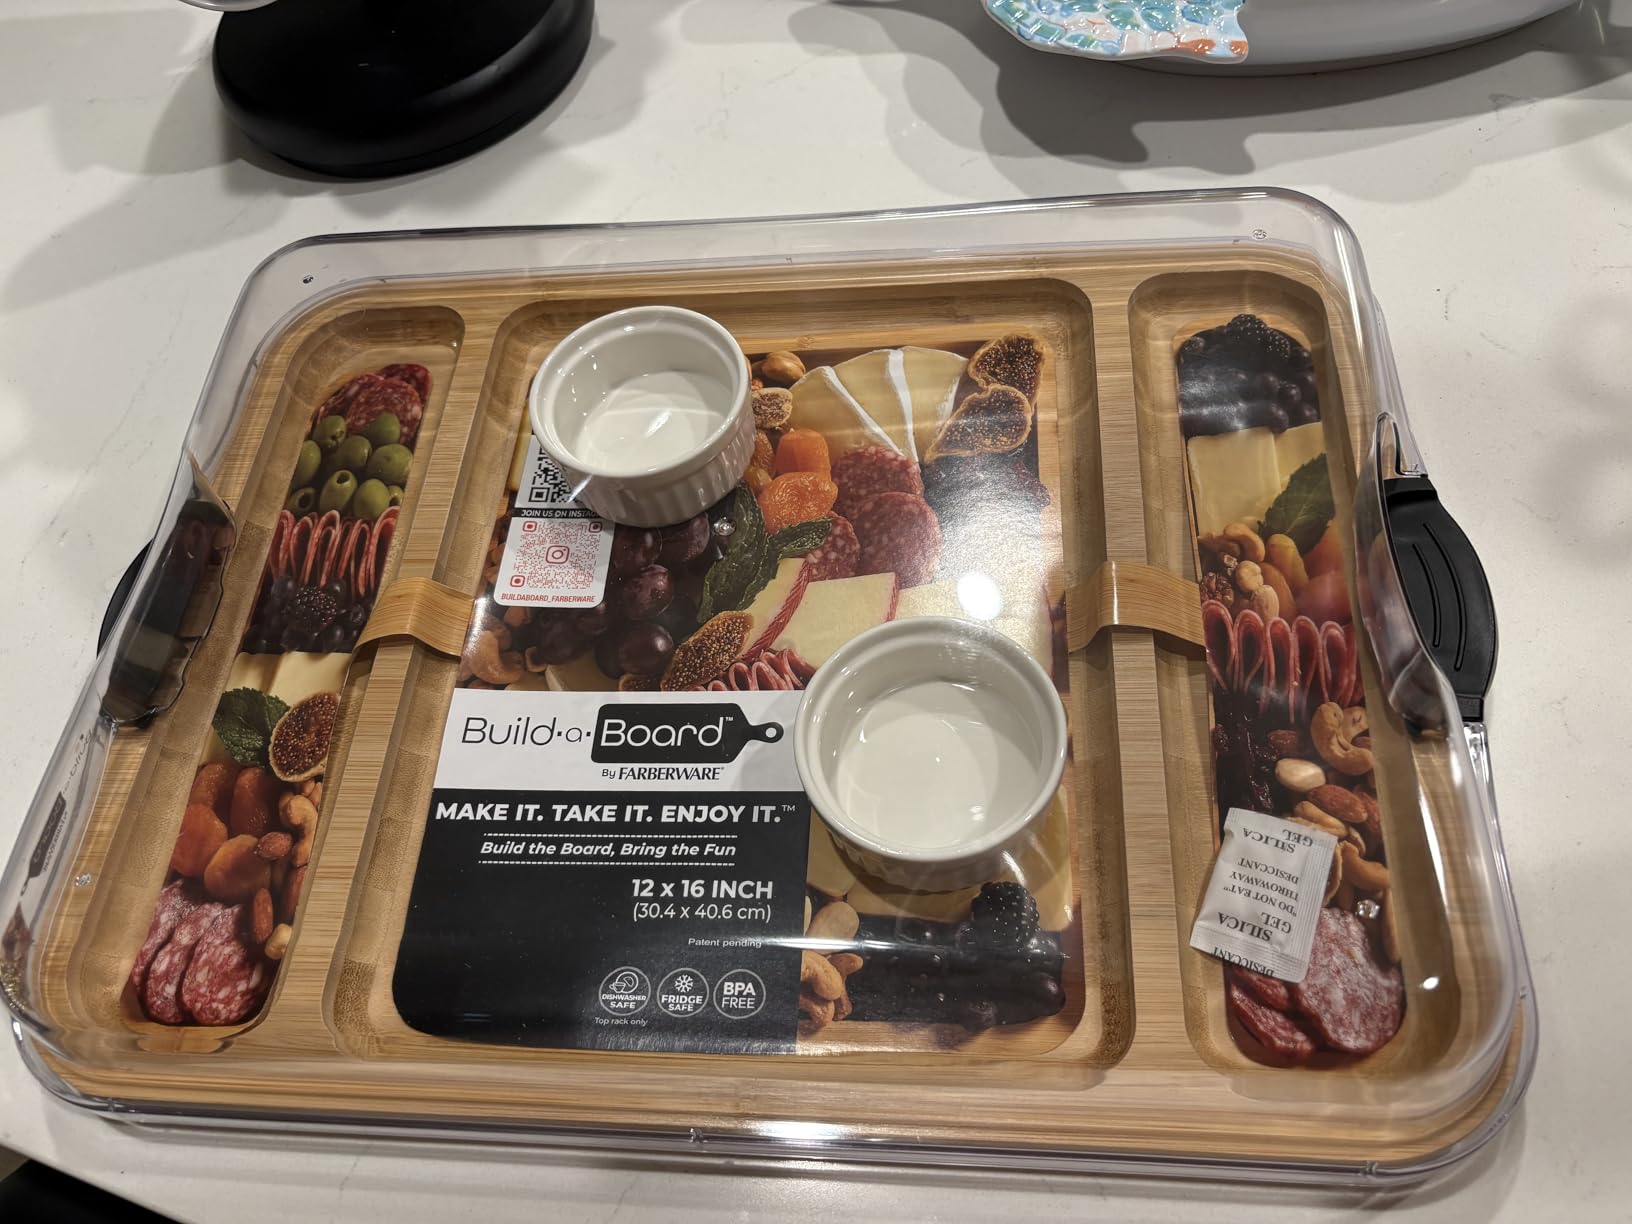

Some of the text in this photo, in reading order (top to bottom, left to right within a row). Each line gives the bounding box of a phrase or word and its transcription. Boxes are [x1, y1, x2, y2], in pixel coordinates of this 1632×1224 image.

[520, 509, 598, 518] JOIN US ON INSTAG
[602, 768, 617, 780] By
[435, 802, 510, 821] MAKE
[515, 804, 544, 822] IT.
[552, 804, 618, 822] TAKE
[624, 805, 653, 823] IT.
[661, 805, 746, 824] ENJOY
[1243, 827, 1297, 854] SILICA
[1282, 829, 1313, 847] GEL
[480, 841, 737, 859] Build the Board, Bring the Fun
[1238, 857, 1299, 884] DESICCANT
[632, 879, 774, 900] 12 x 16 INCH
[1229, 870, 1299, 901] THROWAWAY
[1252, 891, 1277, 907] NOT
[633, 902, 772, 923] (30.4 x 40.6 cm)
[1217, 911, 1273, 942] SILICA
[1261, 911, 1292, 934] GEL
[688, 937, 762, 948] Patent pending
[1213, 946, 1274, 978] DESICCANT
[602, 993, 647, 1001] DISHWASHER
[723, 981, 757, 997] BPA
[610, 1001, 636, 1009] SAFE
[661, 994, 703, 1004] FRIDGE
[721, 997, 756, 1009] FREE
[668, 1004, 694, 1012] SAFE
[594, 1016, 648, 1027] Top rack only
